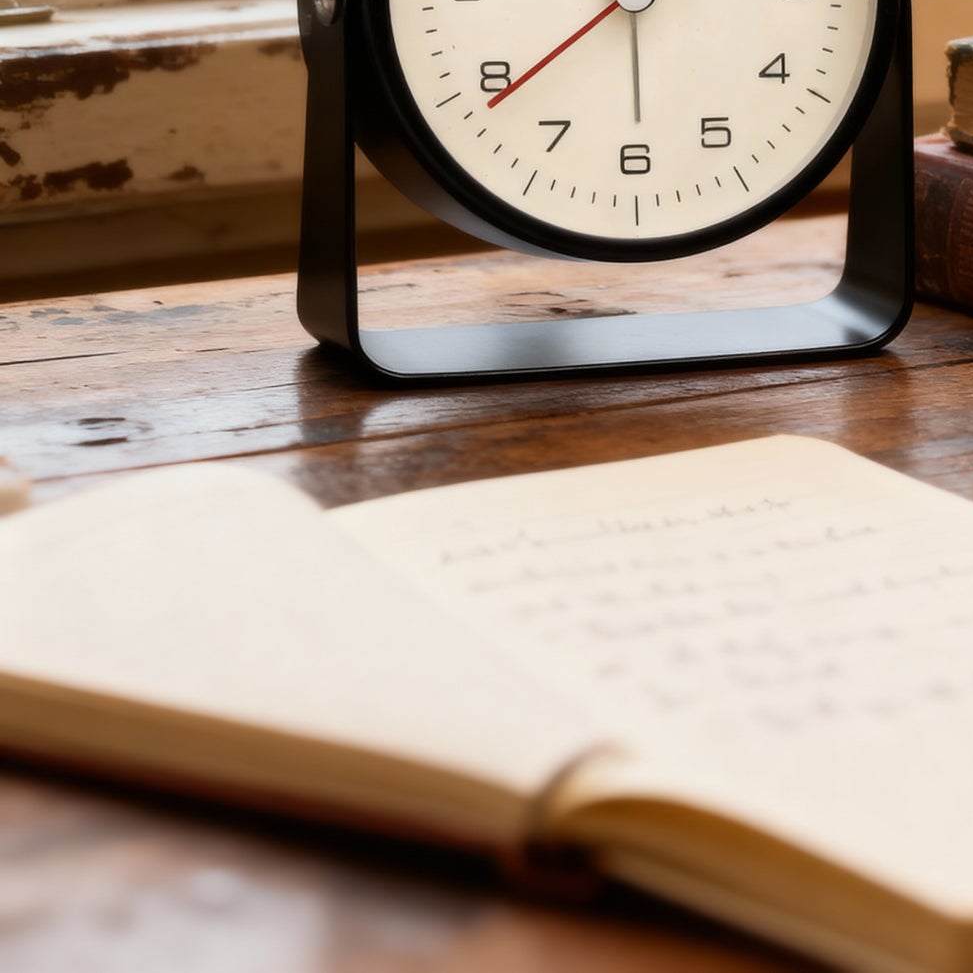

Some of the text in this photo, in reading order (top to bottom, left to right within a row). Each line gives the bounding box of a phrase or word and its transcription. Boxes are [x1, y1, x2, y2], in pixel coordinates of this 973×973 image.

[480, 61, 511, 93] 8
[758, 52, 791, 85] 4
[538, 119, 572, 153] 7
[700, 116, 732, 149] 5
[619, 143, 652, 176] 6
